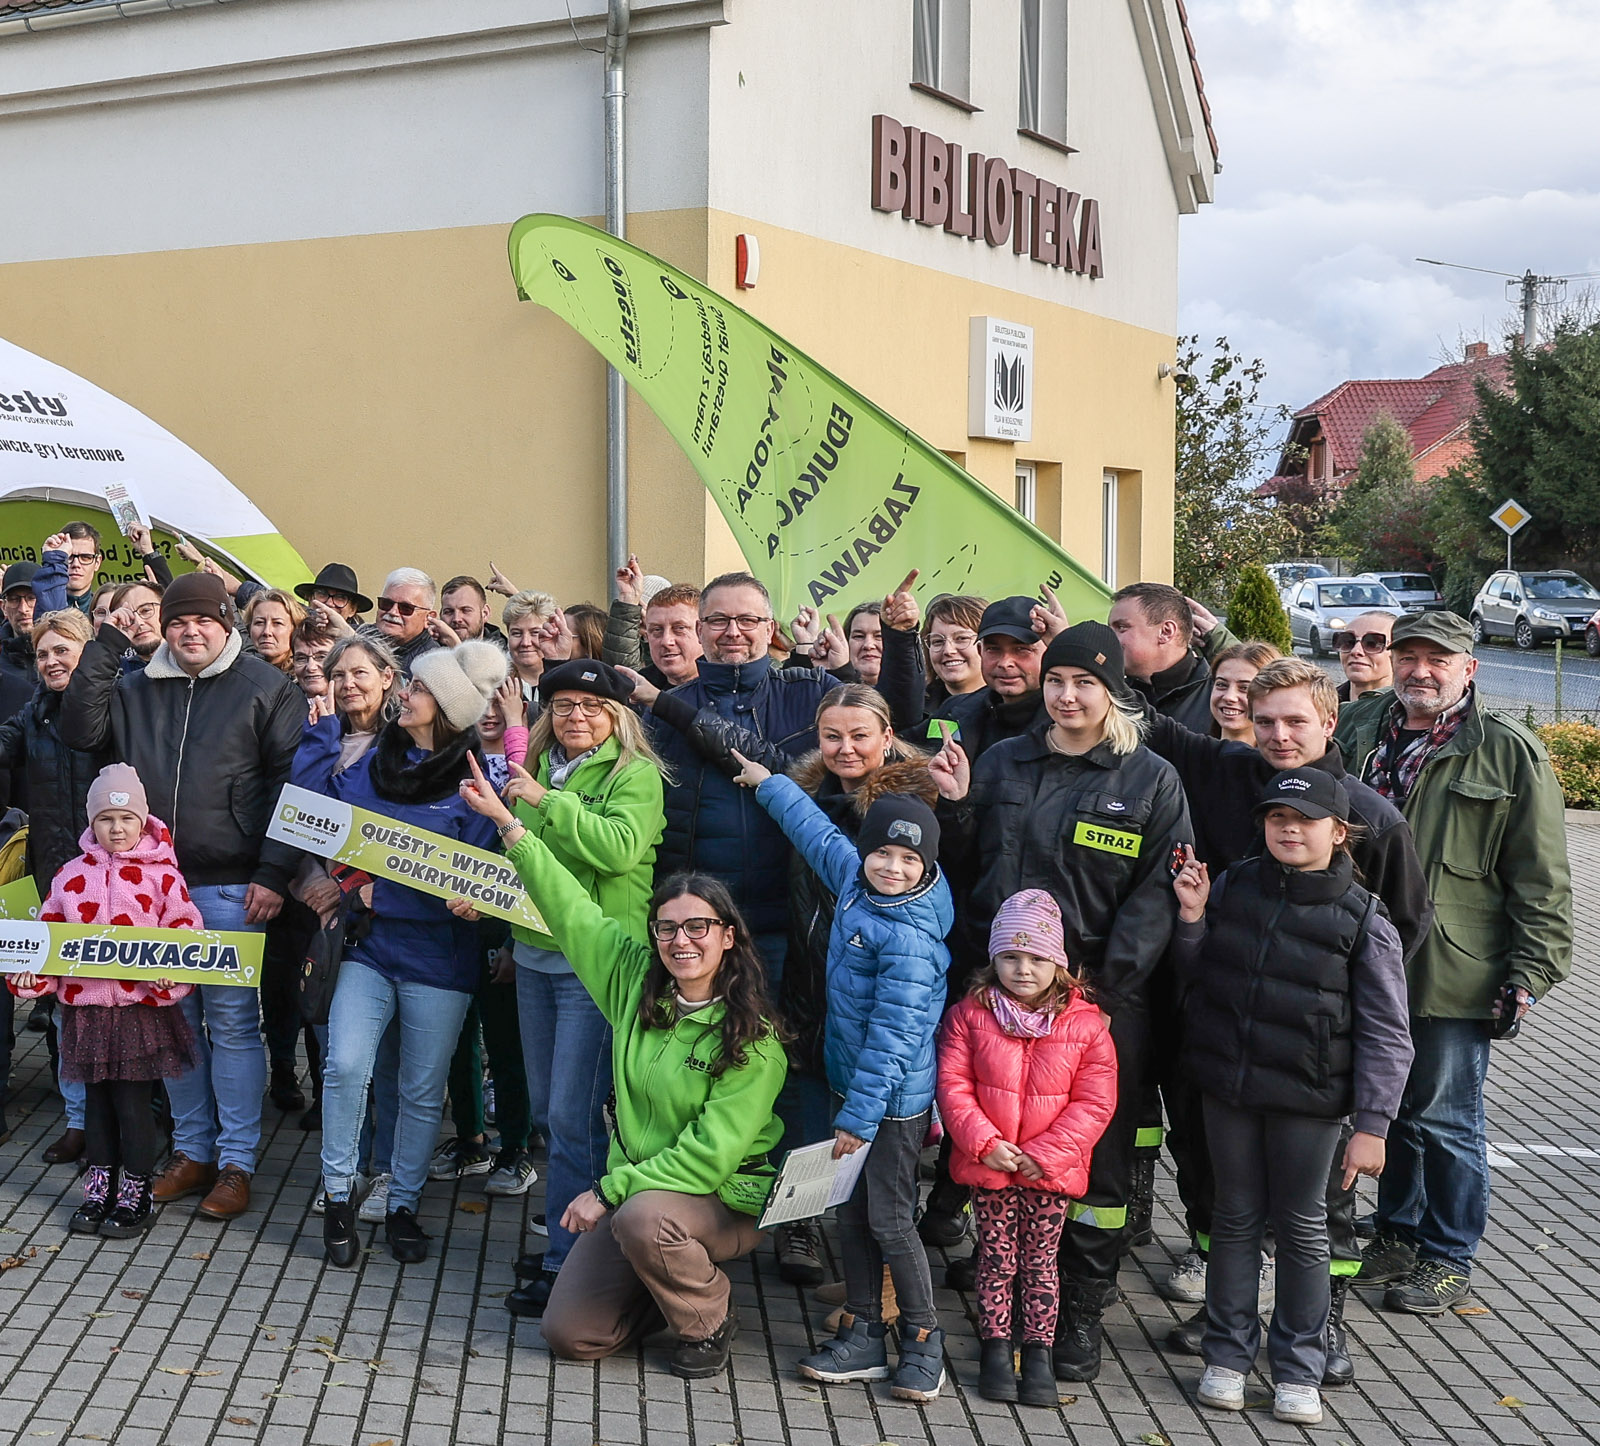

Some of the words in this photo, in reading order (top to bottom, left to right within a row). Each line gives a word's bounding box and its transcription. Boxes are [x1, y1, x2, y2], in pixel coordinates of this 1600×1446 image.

[871, 114, 1104, 279] BIBLIOTEKA
[25, 416, 74, 427] ODKRYWCÓW
[33, 442, 59, 460] gry
[56, 442, 126, 462] terenowe
[1278, 778, 1312, 789] LONDON
[279, 803, 341, 833] Questy
[359, 822, 439, 859] QUESTY
[451, 851, 520, 893] WYPRA
[386, 855, 518, 912] ODKRYWCÓW
[60, 938, 241, 971] #EDUKACJA
